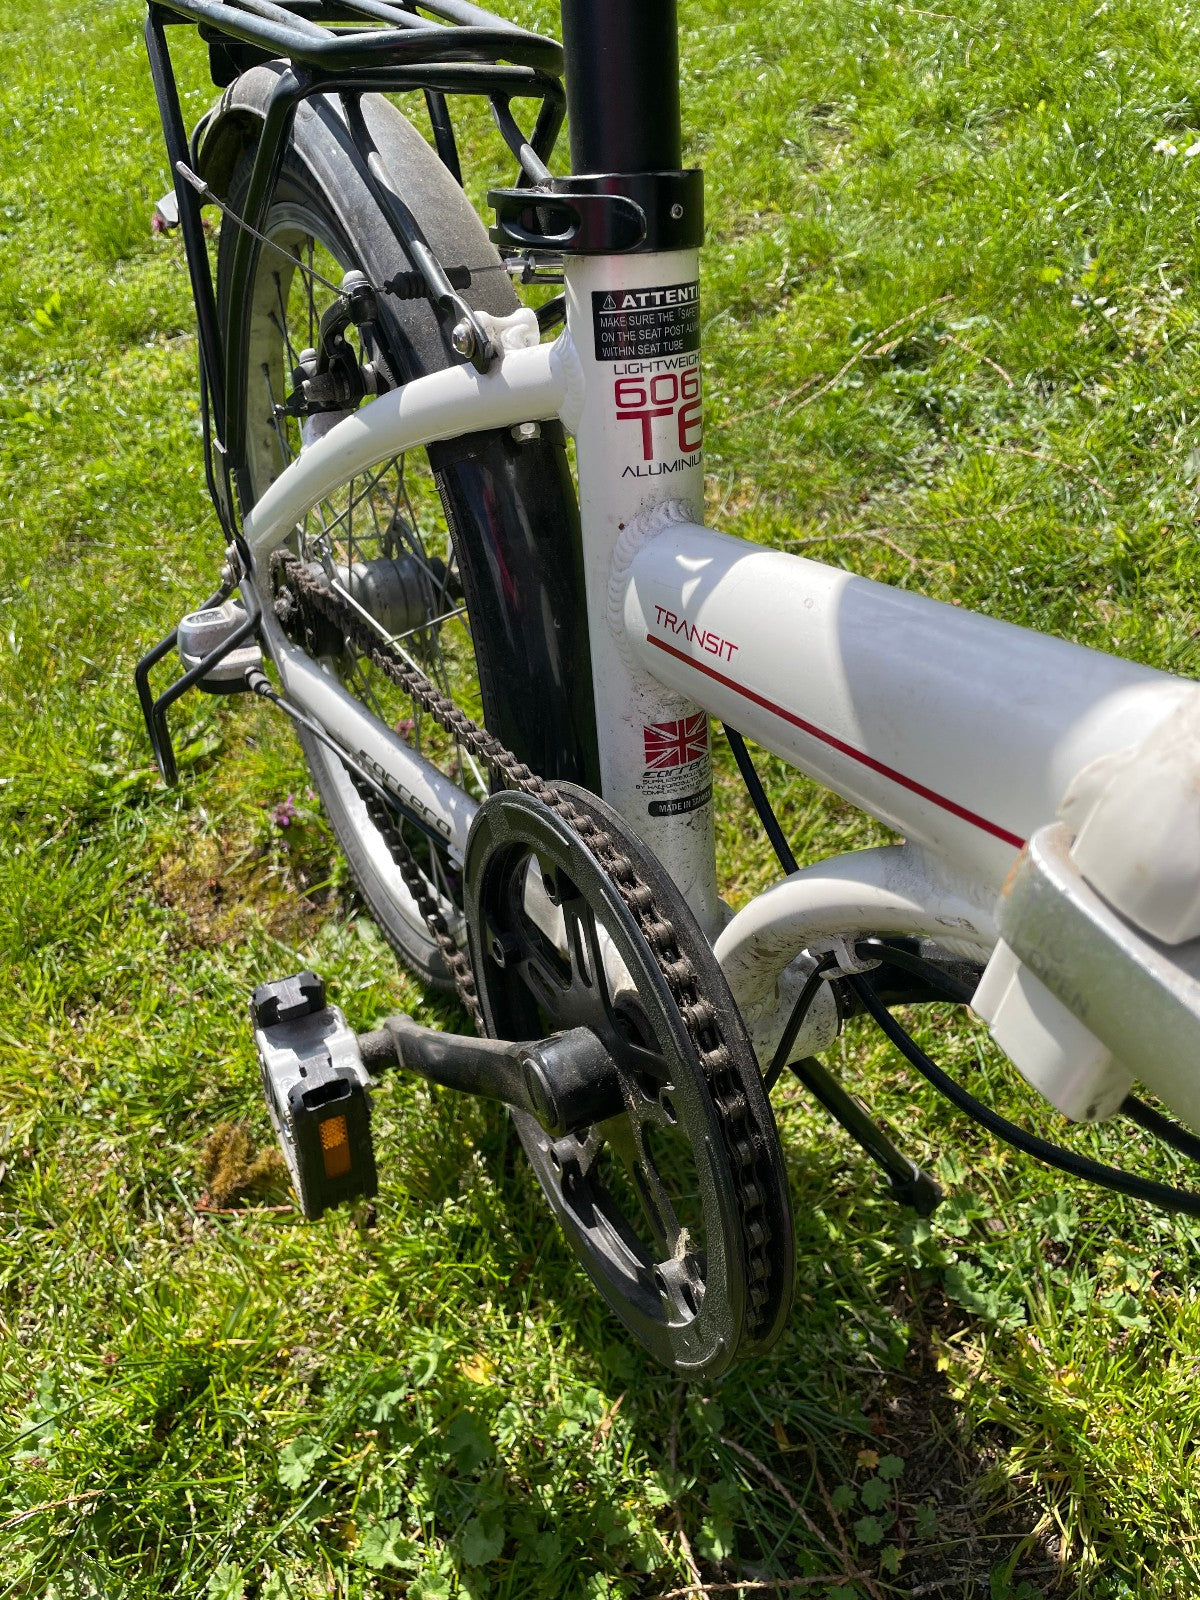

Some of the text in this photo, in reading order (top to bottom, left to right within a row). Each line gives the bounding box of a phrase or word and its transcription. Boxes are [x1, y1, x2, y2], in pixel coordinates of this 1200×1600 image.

[621, 285, 699, 308] ATTENTI
[600, 316, 627, 328] MAKE
[628, 313, 655, 326] SURE
[657, 311, 675, 323] THE
[601, 332, 615, 343] ON
[617, 330, 637, 342] THE
[638, 327, 662, 340] SEAT
[664, 324, 684, 337] POST
[601, 339, 684, 357] WITHIN SEAT TUBE
[613, 353, 700, 375] LIGHTWEIGH
[615, 398, 703, 461] T6
[621, 451, 701, 478] ALUMINIU
[654, 604, 739, 662] TRANSIT
[659, 802, 682, 813] MADE
[683, 800, 691, 809] IN
